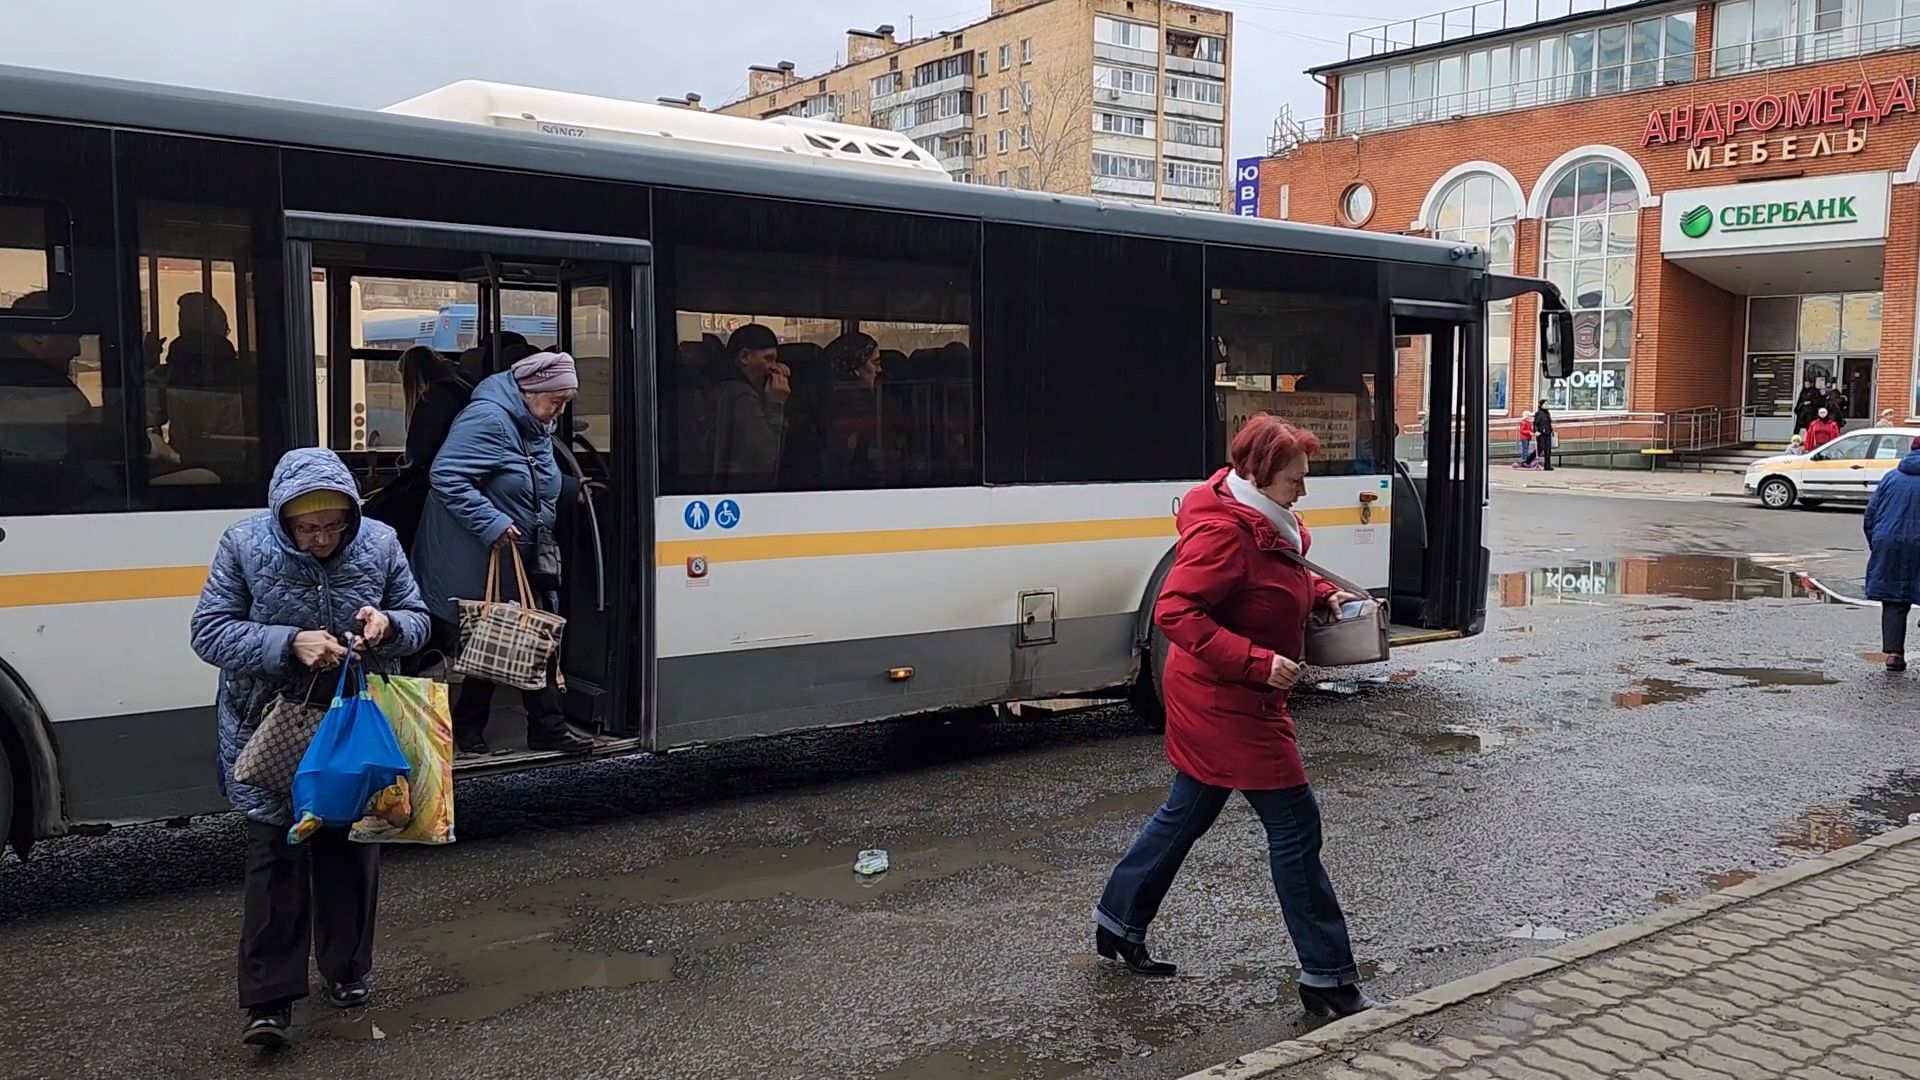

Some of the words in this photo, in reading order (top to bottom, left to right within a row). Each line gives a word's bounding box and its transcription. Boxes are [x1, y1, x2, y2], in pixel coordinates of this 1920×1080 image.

[1641, 75, 1916, 147] АНДРОМЕДА
[1686, 129, 1865, 171] МЕБЕЛЬ
[1719, 196, 1857, 227] СБЕРБАНК
